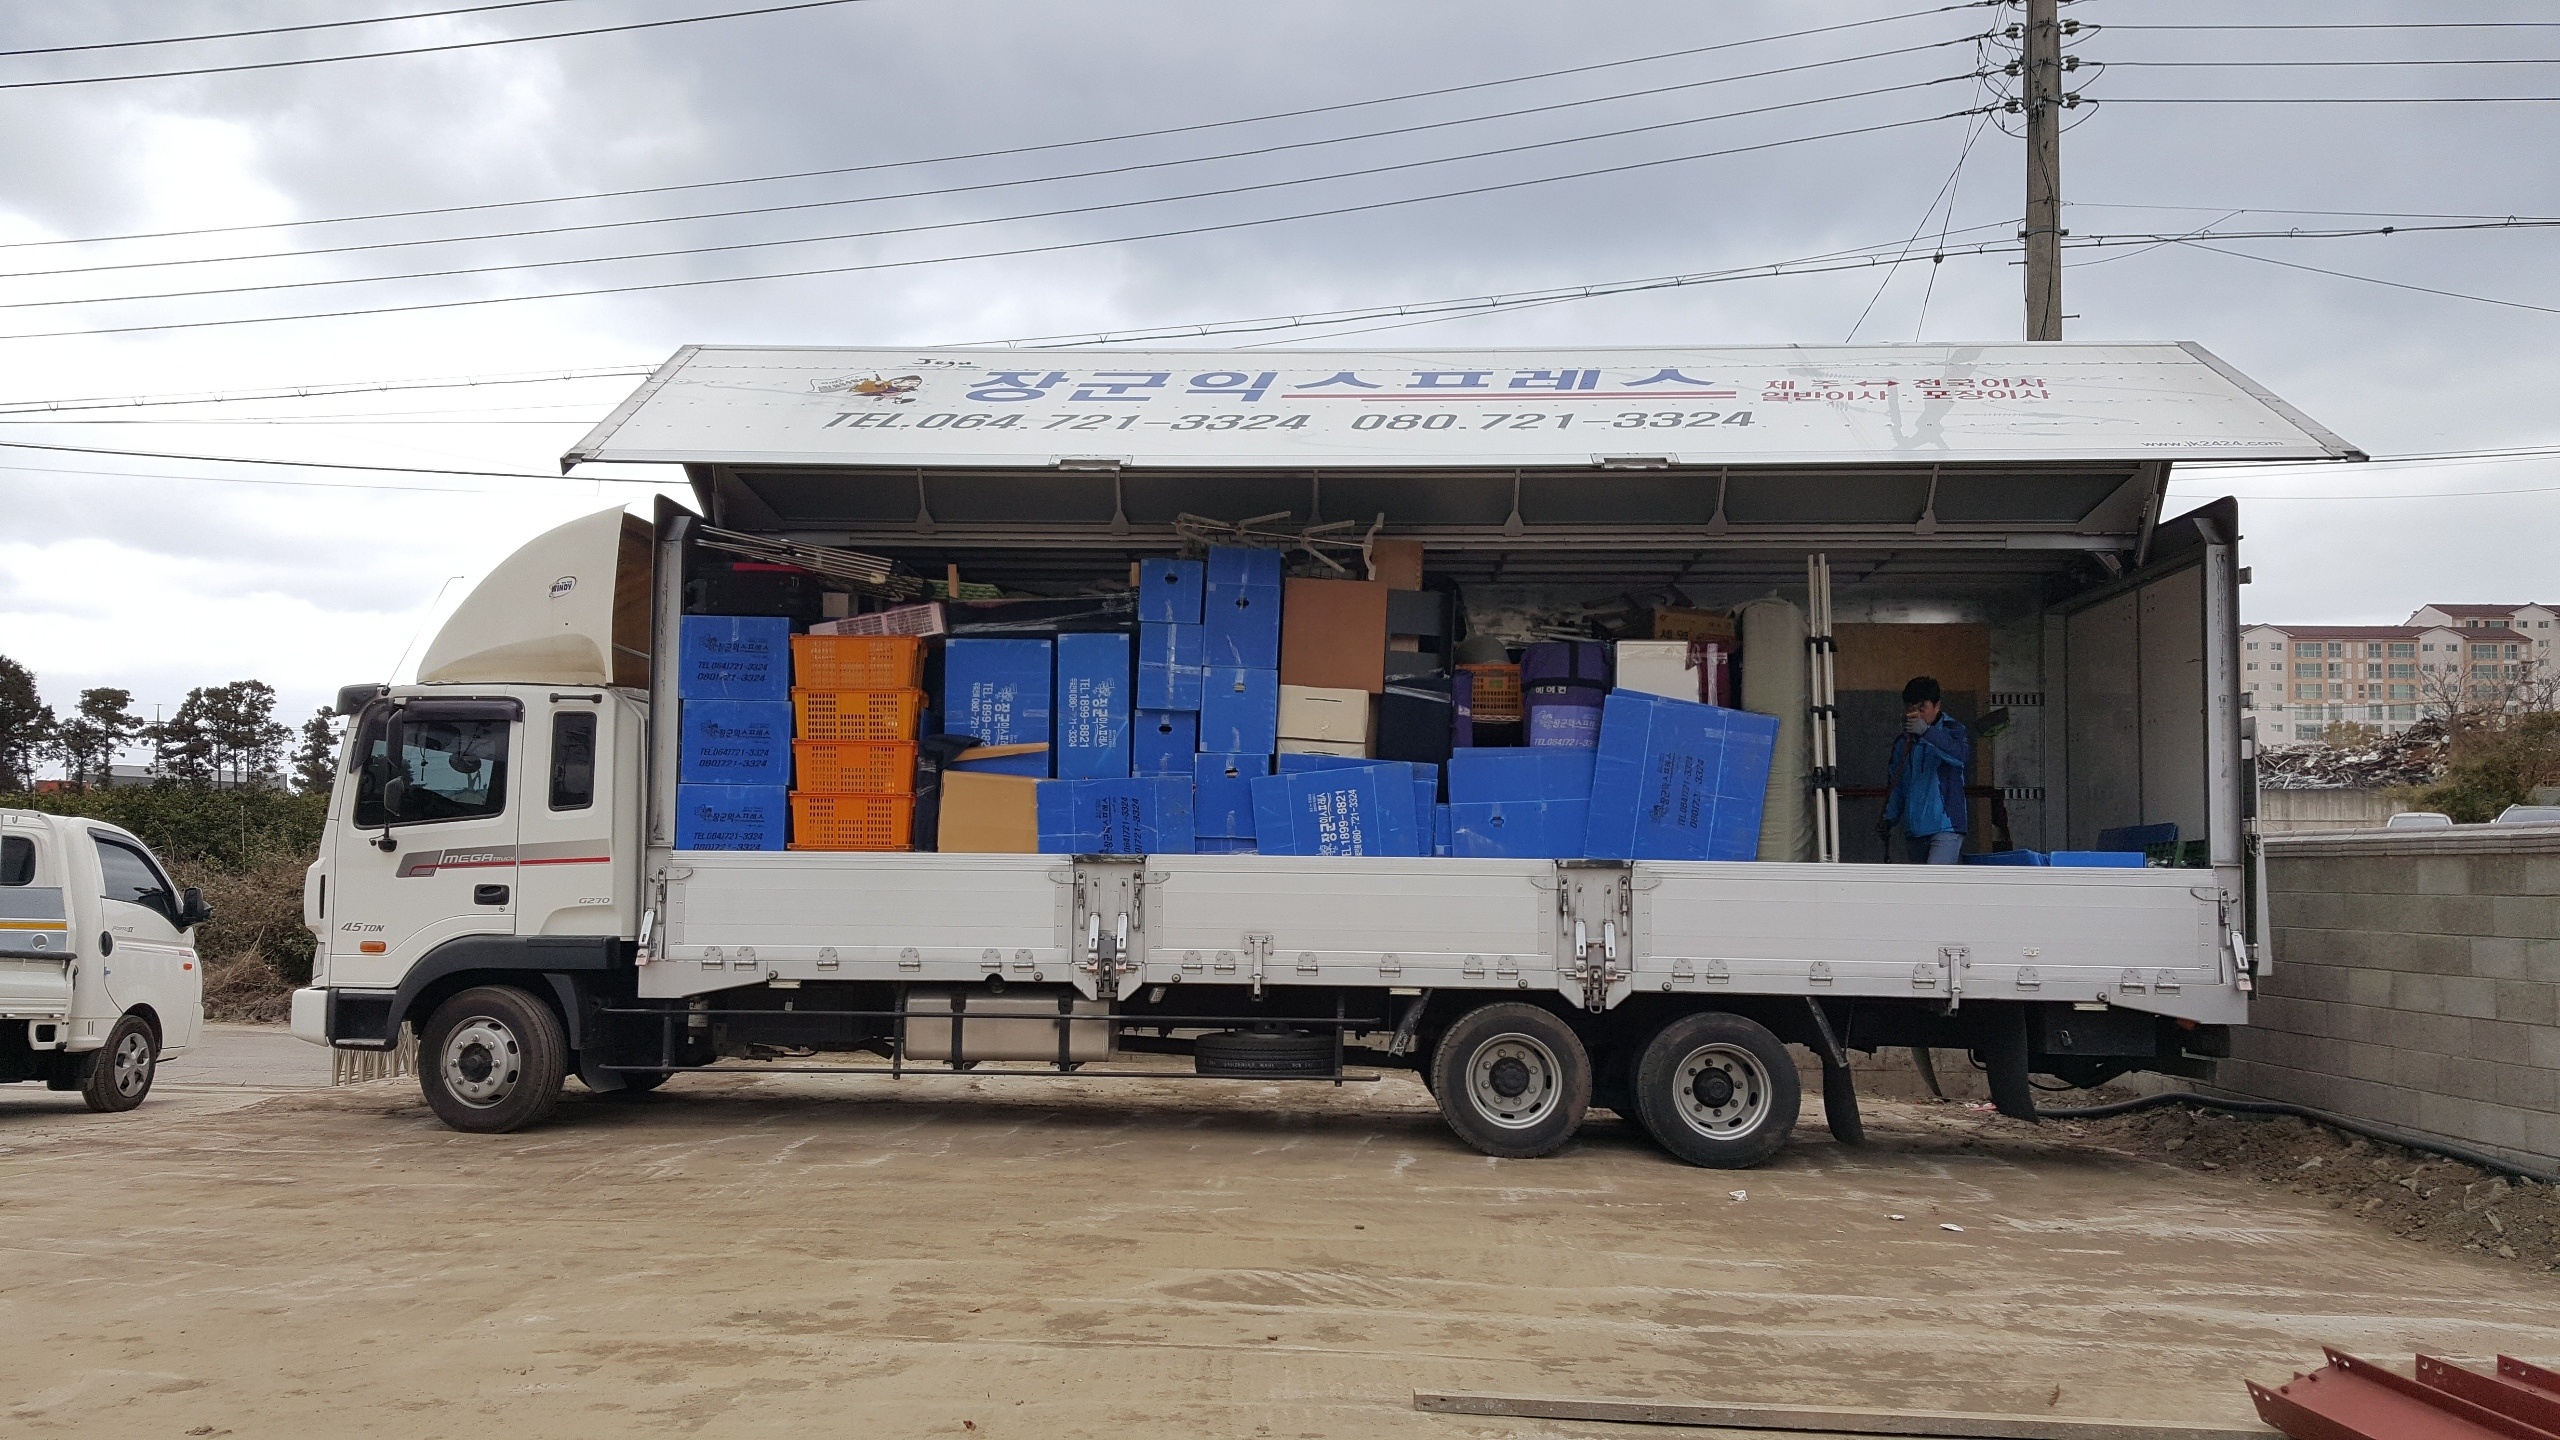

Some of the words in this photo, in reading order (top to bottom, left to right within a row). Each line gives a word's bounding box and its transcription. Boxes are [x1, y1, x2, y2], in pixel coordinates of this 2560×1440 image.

[964, 369, 1716, 402] 장군익스프레스
[1912, 378, 2047, 389] 전국이사
[1761, 390, 1889, 402] 일반이사
[1922, 389, 2052, 400] 포장이사
[1351, 410, 1756, 430] 080.721-3324
[2141, 440, 2284, 448] www.jk2424.com
[551, 582, 573, 593] WINDY
[1535, 686, 1567, 694] 에어컨
[980, 682, 994, 747] TEL.1899-882
[1092, 698, 1108, 748] 장군익스프레스
[1316, 792, 1337, 843] 장군익스프레스
[443, 853, 494, 863] MEGA
[363, 924, 386, 932] TON
